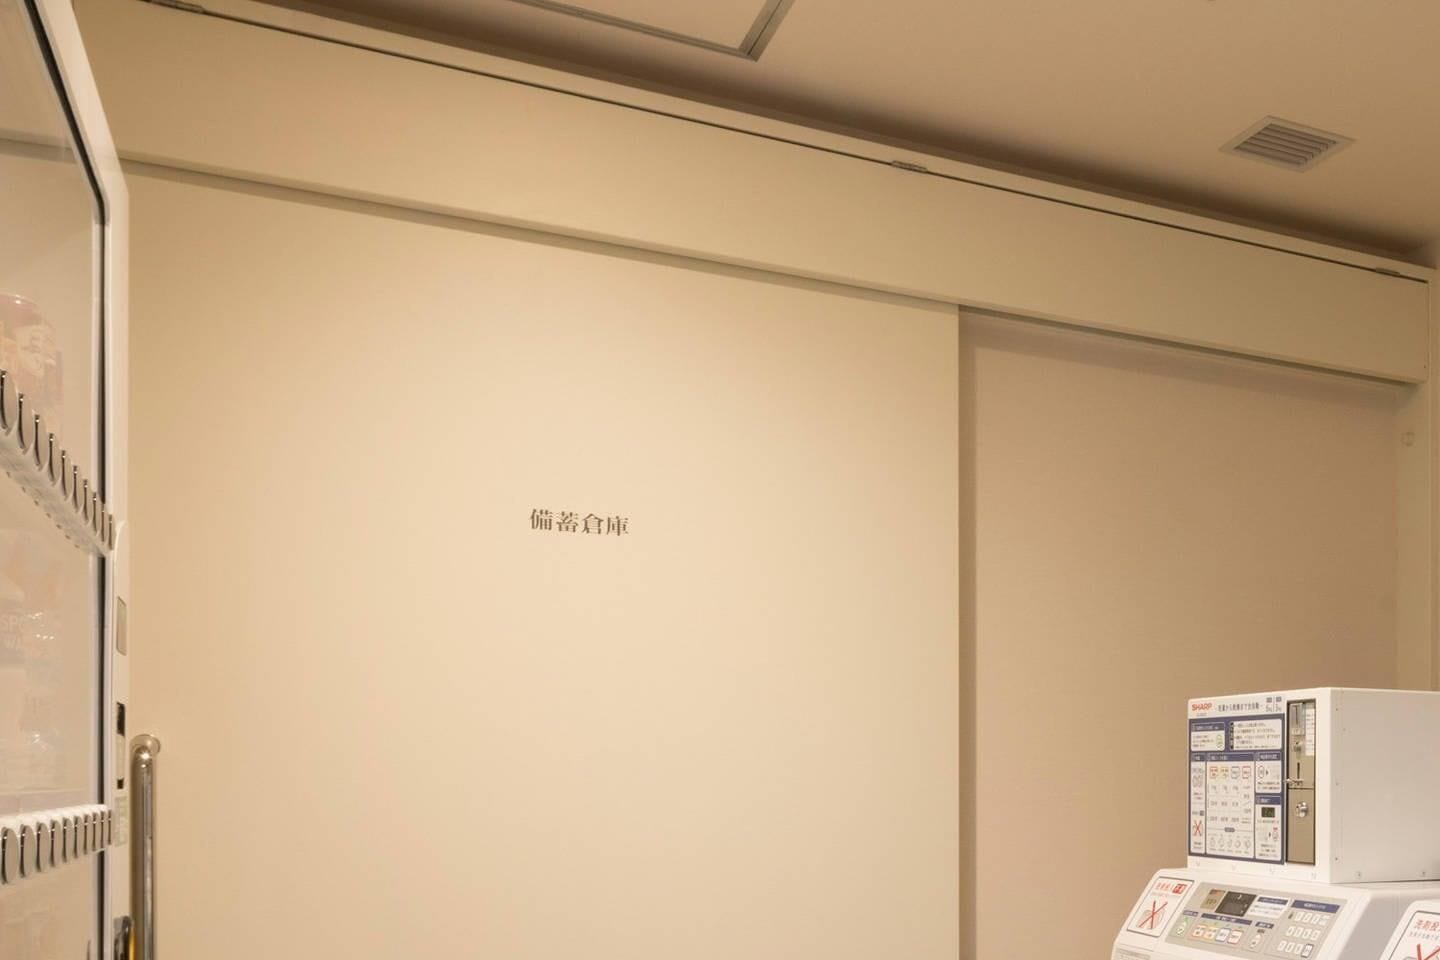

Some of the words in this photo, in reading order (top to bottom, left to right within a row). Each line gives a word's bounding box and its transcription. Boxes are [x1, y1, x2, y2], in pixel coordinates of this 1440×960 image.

[530, 509, 629, 536] 備蓄倉庫
[1191, 702, 1212, 712] SHARP
